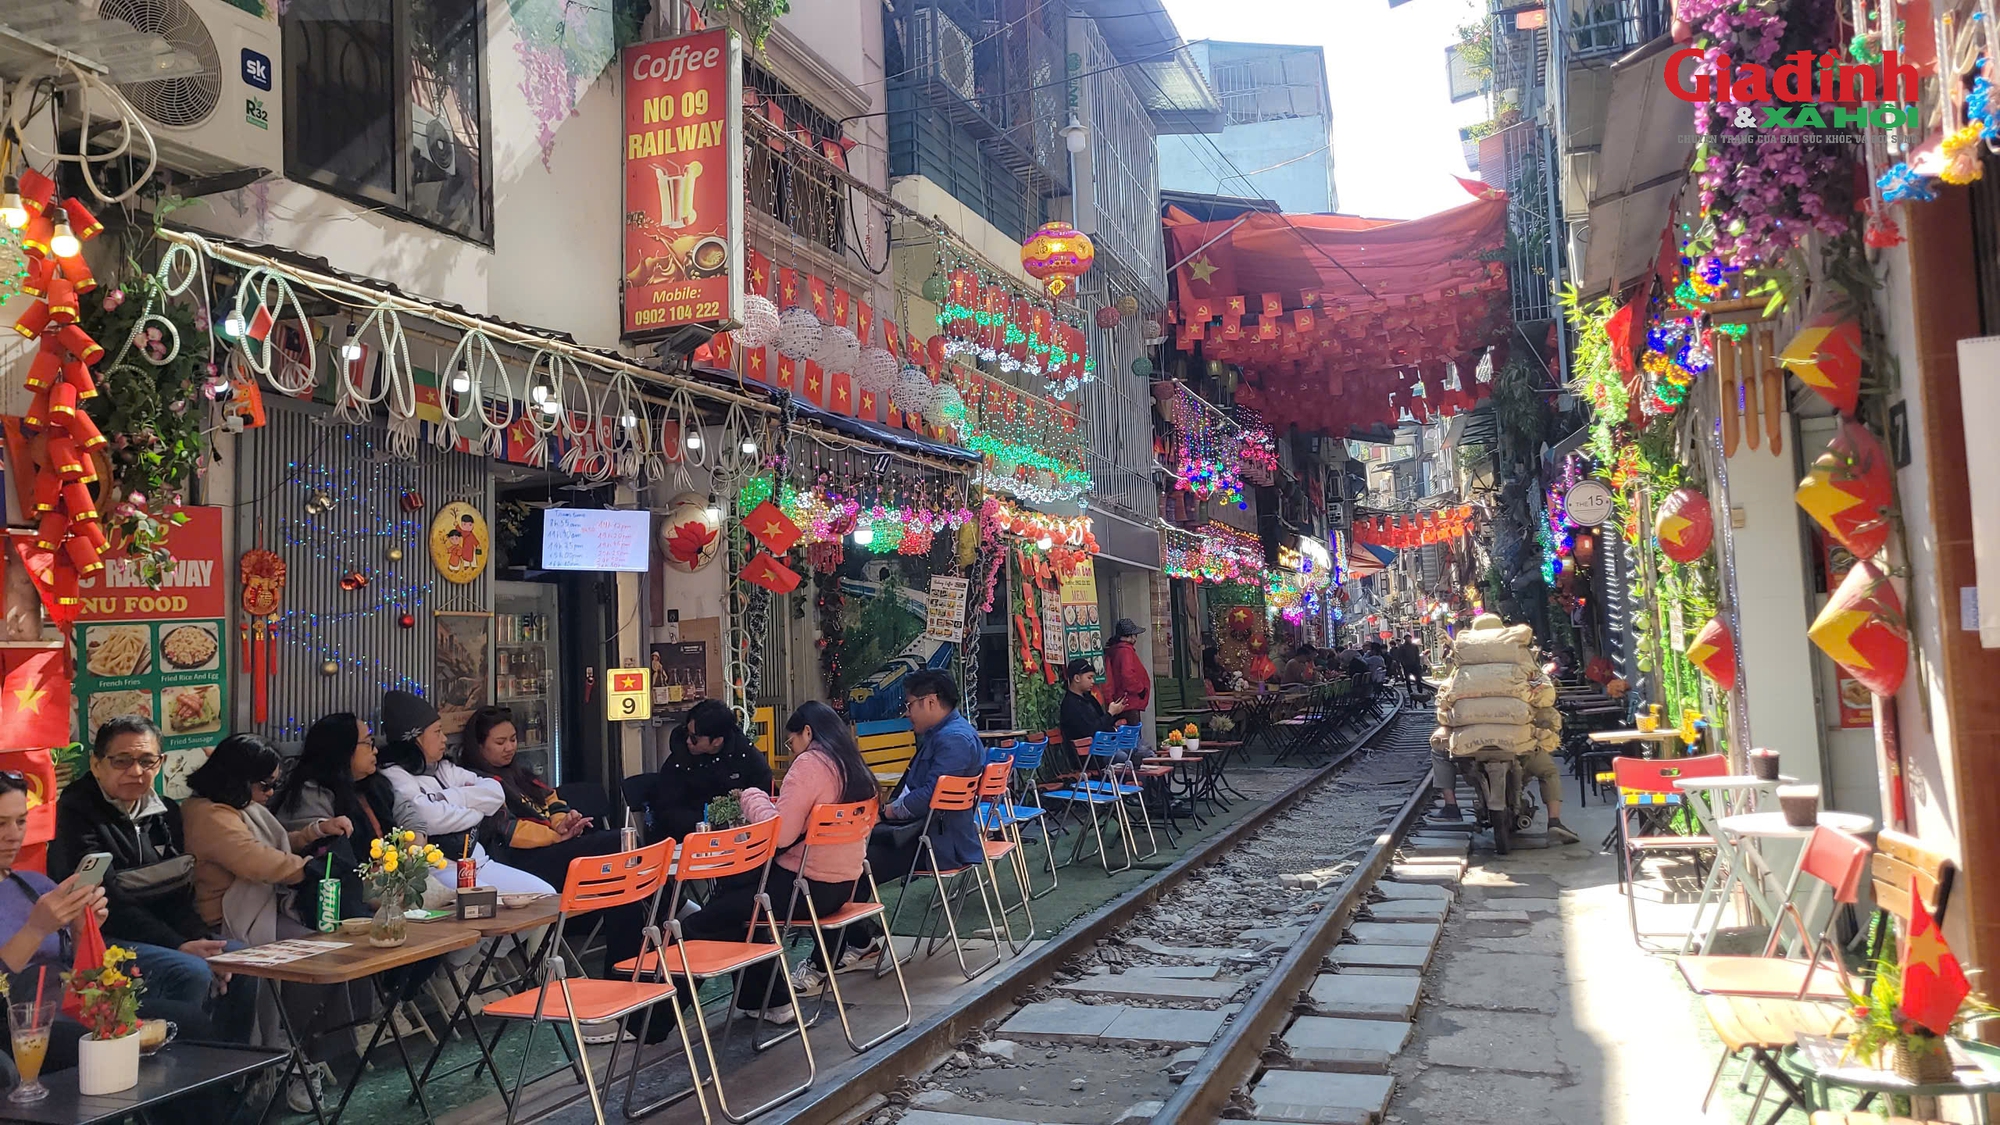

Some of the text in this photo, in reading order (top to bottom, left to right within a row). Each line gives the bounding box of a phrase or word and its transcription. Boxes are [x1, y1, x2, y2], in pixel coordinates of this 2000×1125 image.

[246, 59, 267, 80] sk
[632, 44, 720, 82] Coffee
[643, 89, 709, 124] NO 09
[628, 119, 725, 160] RAILWAY
[652, 287, 702, 304] Mobile:
[635, 301, 720, 326] 0902 104 222
[1588, 494, 1604, 507] 15
[105, 559, 214, 588] RAIWAY
[81, 595, 188, 614] NU FOOD
[99, 678, 141, 688] French Fries
[161, 672, 220, 683] Fried Rice And Egg
[622, 697, 636, 715] 9
[170, 736, 214, 746] Fried Sausage
[318, 881, 337, 933] Sprite
